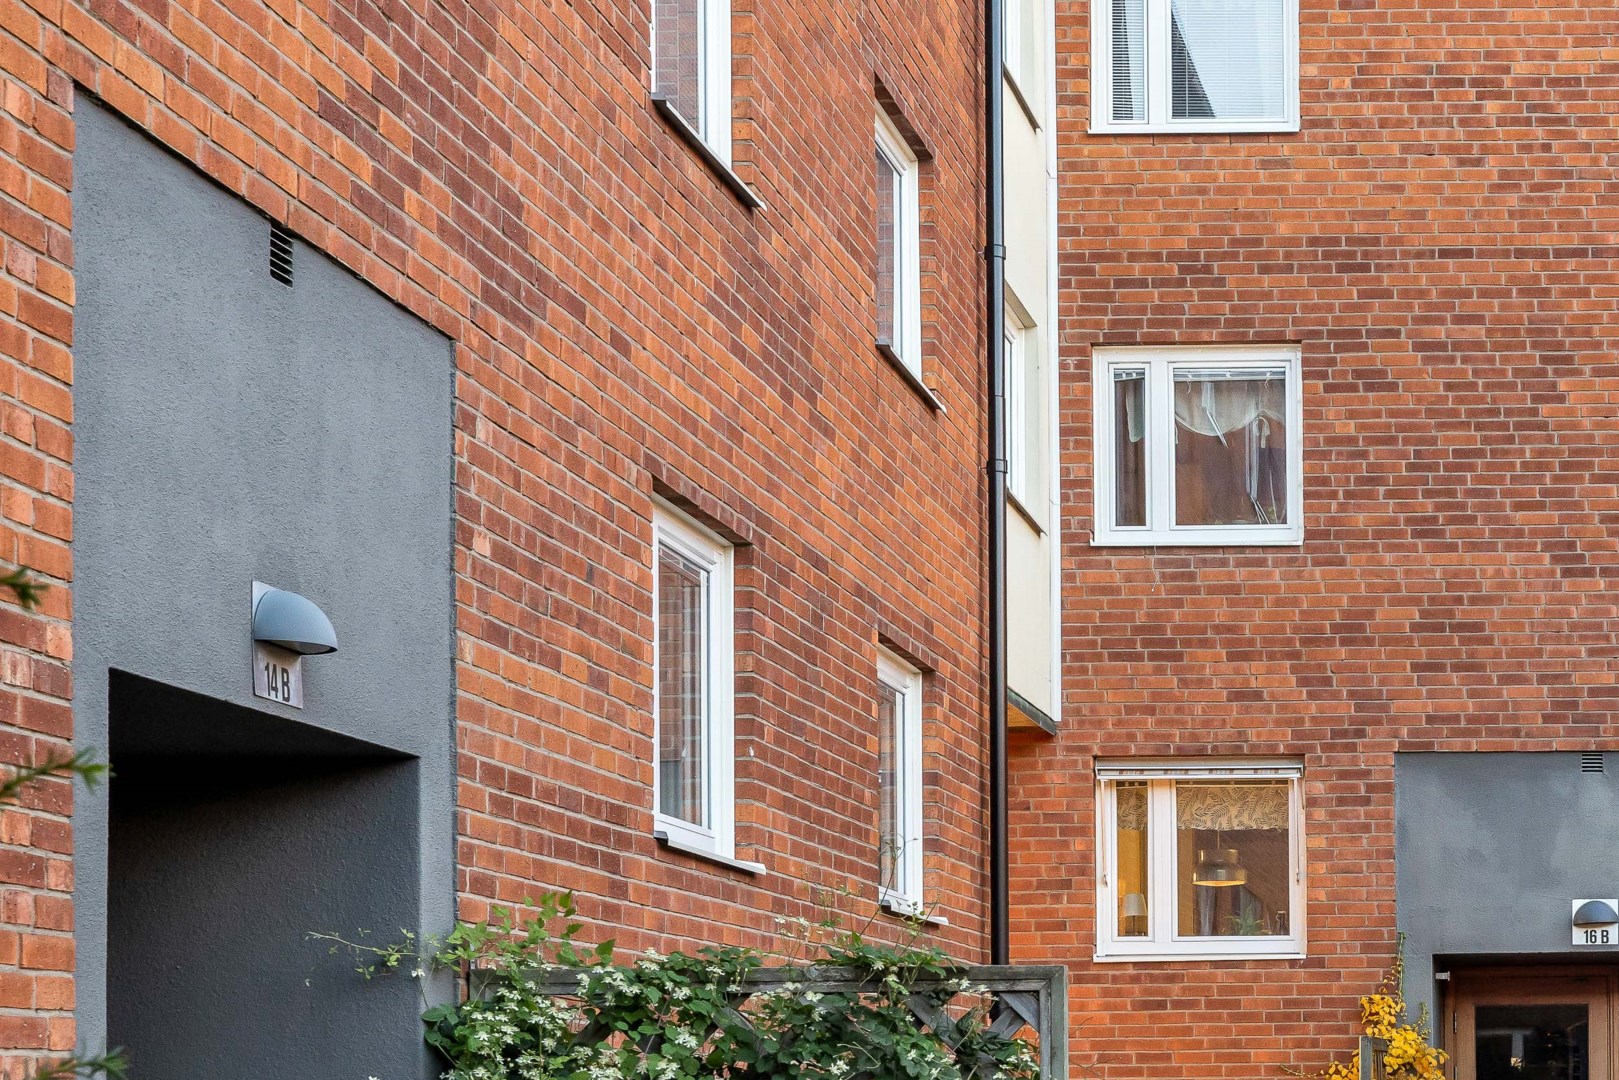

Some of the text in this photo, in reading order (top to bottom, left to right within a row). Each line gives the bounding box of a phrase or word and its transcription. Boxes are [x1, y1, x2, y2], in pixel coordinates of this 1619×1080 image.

[265, 661, 290, 703] 14 B
[1584, 929, 1609, 944] 16 B
